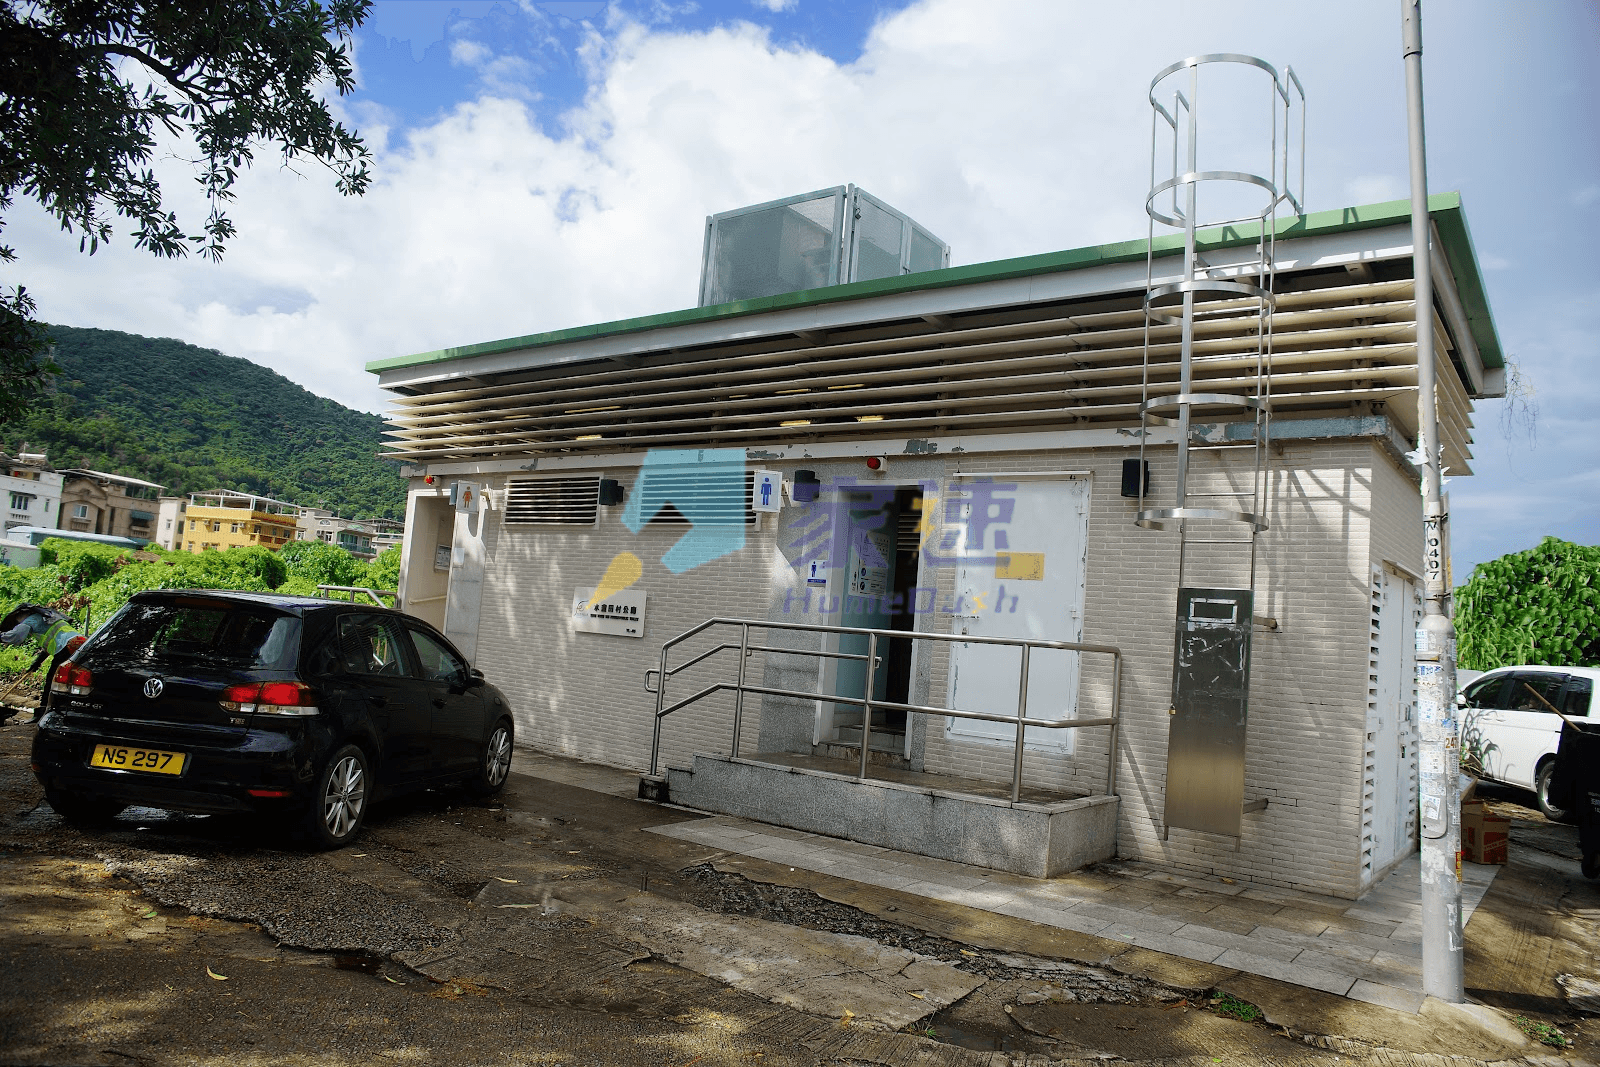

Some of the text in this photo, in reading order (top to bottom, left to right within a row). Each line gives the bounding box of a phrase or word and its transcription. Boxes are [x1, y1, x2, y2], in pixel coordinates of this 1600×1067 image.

[1429, 538, 1439, 580] 0407
[100, 747, 174, 769] NS 297
